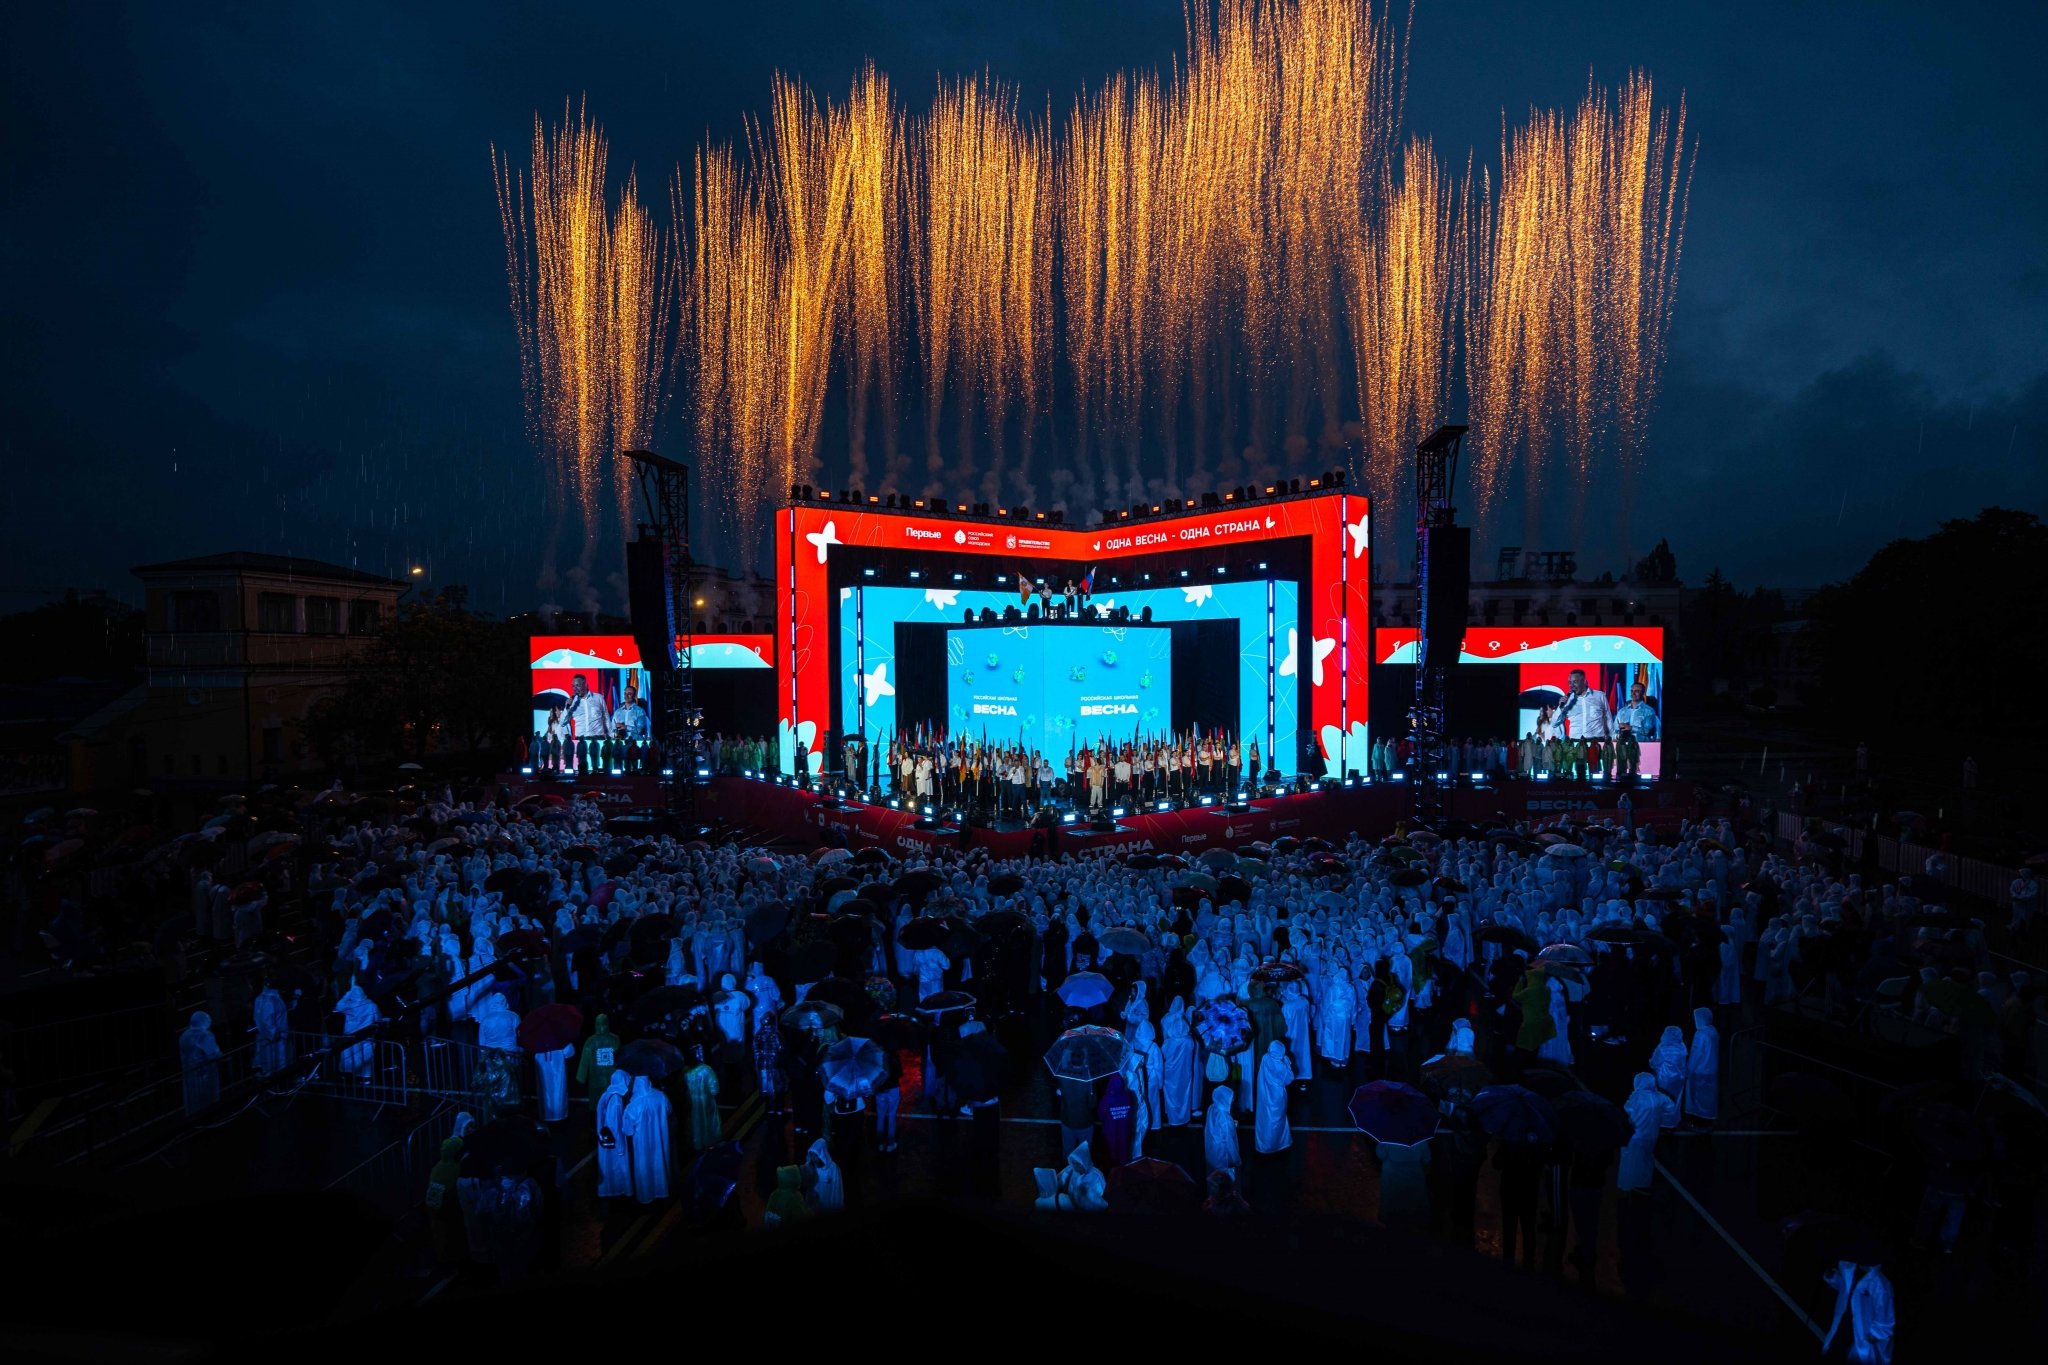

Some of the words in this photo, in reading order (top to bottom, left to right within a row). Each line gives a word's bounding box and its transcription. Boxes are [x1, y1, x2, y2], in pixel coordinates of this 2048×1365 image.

[906, 527, 941, 540] Первые
[1106, 538, 1132, 550] ОДНА
[1135, 532, 1168, 545] ВЕСНА
[1180, 526, 1210, 540] ОДНА
[1214, 519, 1260, 535] СТРАНА
[973, 703, 1018, 716] ВЕСНА
[1080, 703, 1139, 716] ВЕСНА
[1526, 800, 1599, 811] ВЕСНА
[1181, 833, 1207, 845] Первые
